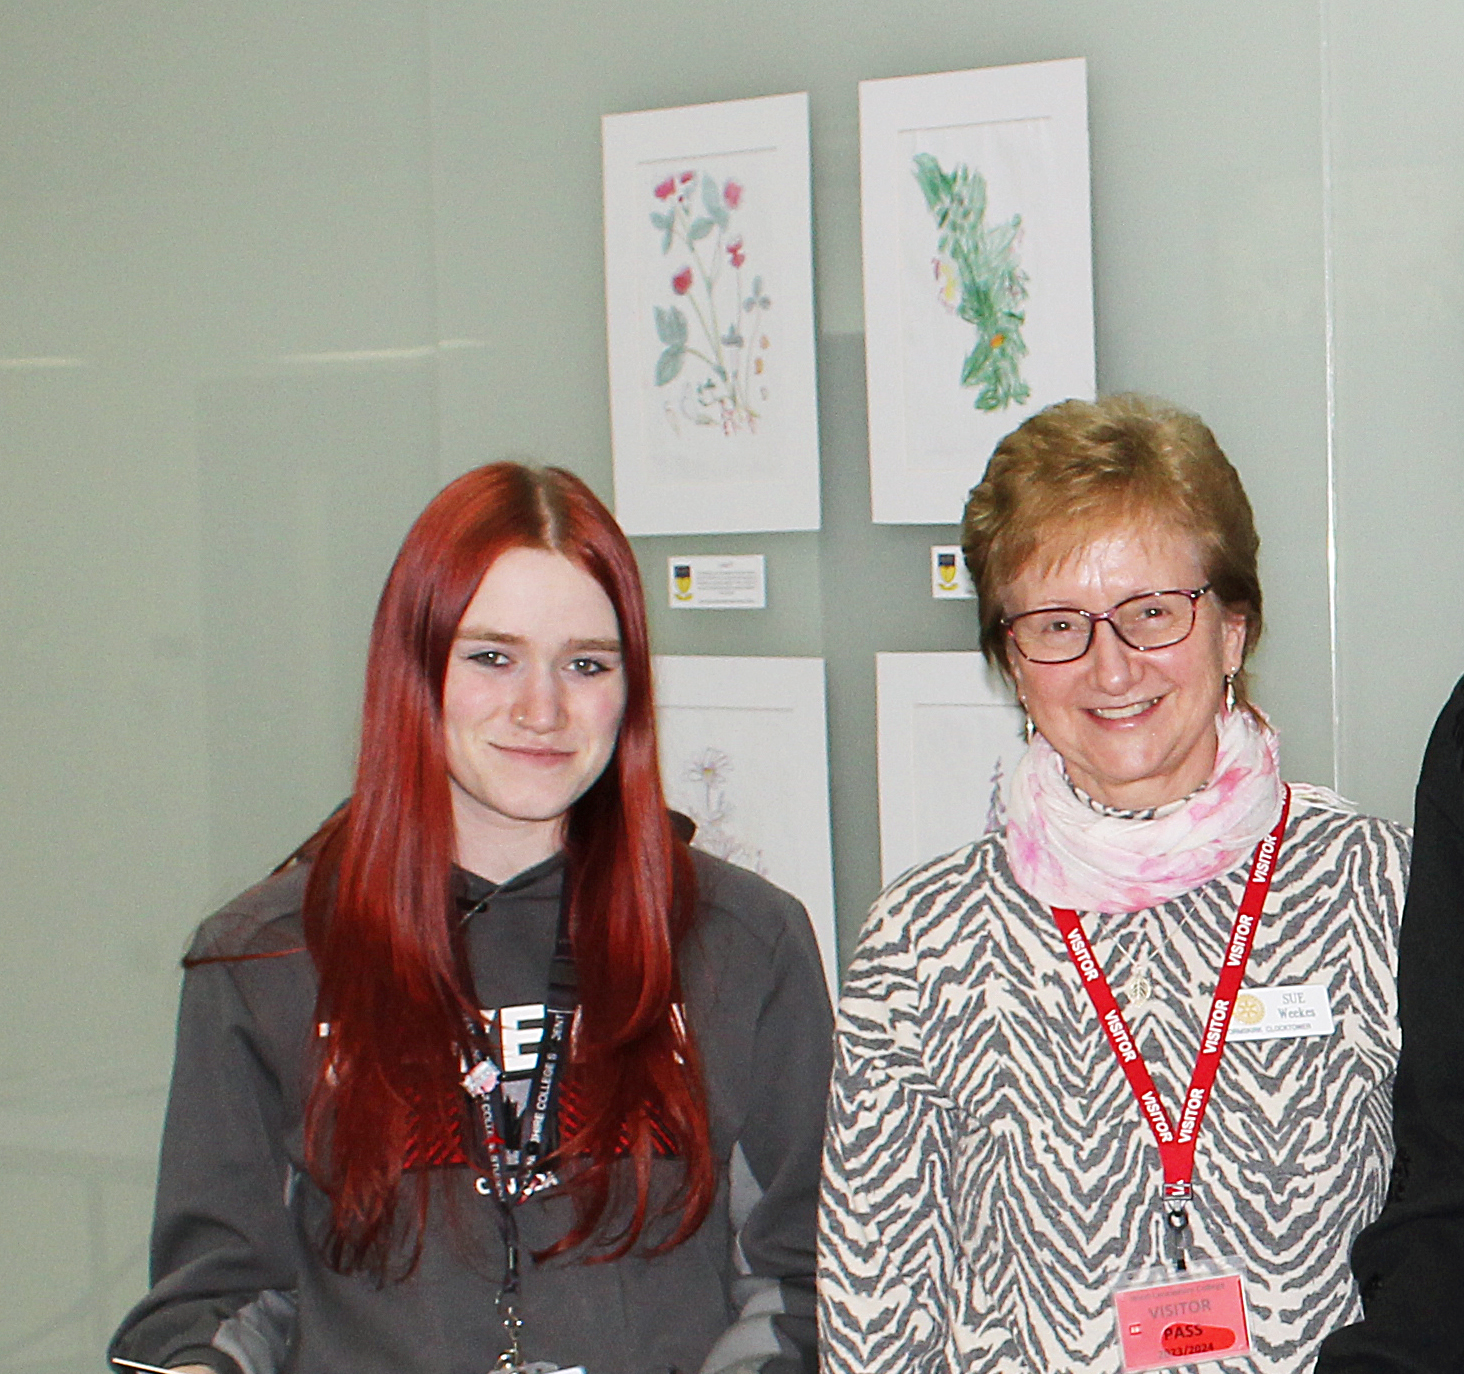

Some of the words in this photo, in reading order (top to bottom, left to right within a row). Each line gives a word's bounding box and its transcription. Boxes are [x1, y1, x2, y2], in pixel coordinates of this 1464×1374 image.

[1253, 834, 1278, 884] VISITOR
[1067, 928, 1099, 982] VISITOR
[1227, 914, 1253, 968] VISITOR
[1278, 1007, 1316, 1019] Weekes
[1282, 992, 1306, 1004] SUE
[1104, 1009, 1137, 1063] VISITOR
[1203, 999, 1230, 1055] VISITOR
[536, 1063, 556, 1111] COLLEGE
[1141, 1091, 1173, 1143] VISITOR
[1178, 1088, 1205, 1144] VISITOR
[1148, 1298, 1211, 1319] VISITOR
[1163, 1324, 1203, 1341] PASS
[1159, 1342, 1214, 1359] 2023/2024
